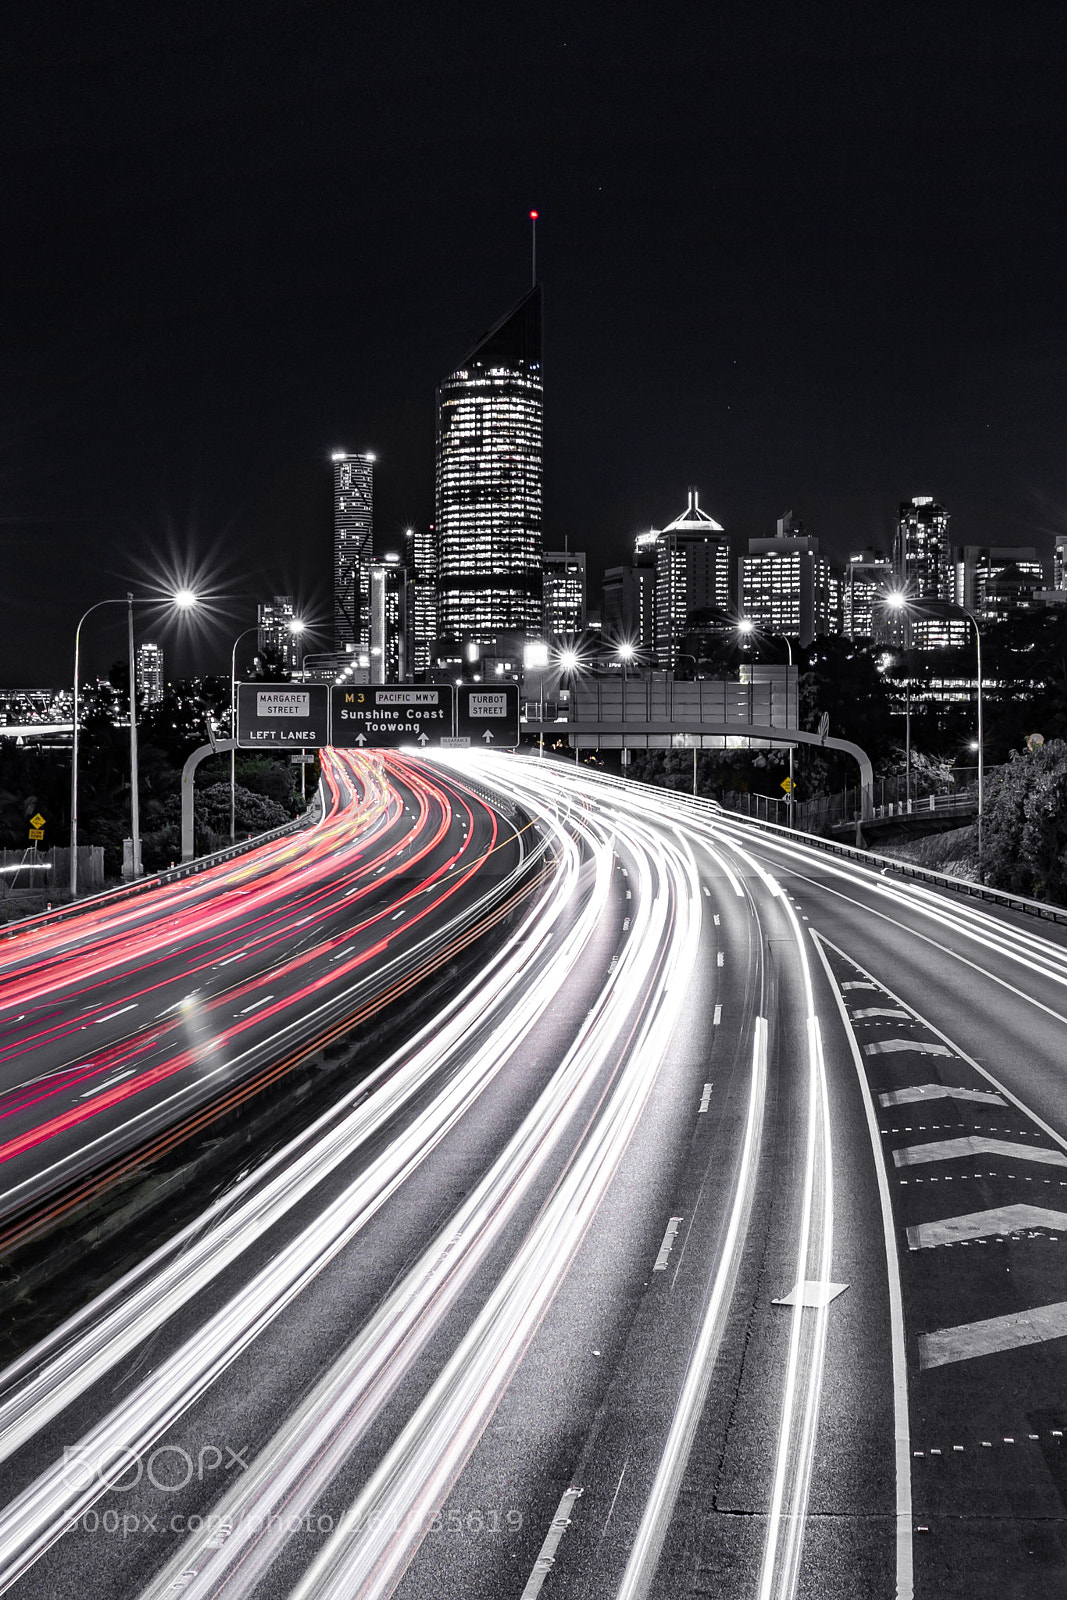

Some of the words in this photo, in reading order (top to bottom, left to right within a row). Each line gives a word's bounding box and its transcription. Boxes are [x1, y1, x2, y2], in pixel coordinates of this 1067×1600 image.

[259, 694, 307, 703] MARGARET
[378, 694, 411, 702] PACIFIC
[415, 694, 436, 702] MWY
[472, 696, 504, 704] TURBOT
[267, 706, 299, 714] STREET
[473, 707, 503, 715] STREET
[341, 710, 400, 719] Sunshine
[406, 710, 444, 719] Coast
[365, 722, 420, 734] Toowong
[250, 732, 277, 740] LEFT
[280, 732, 316, 740] LANES
